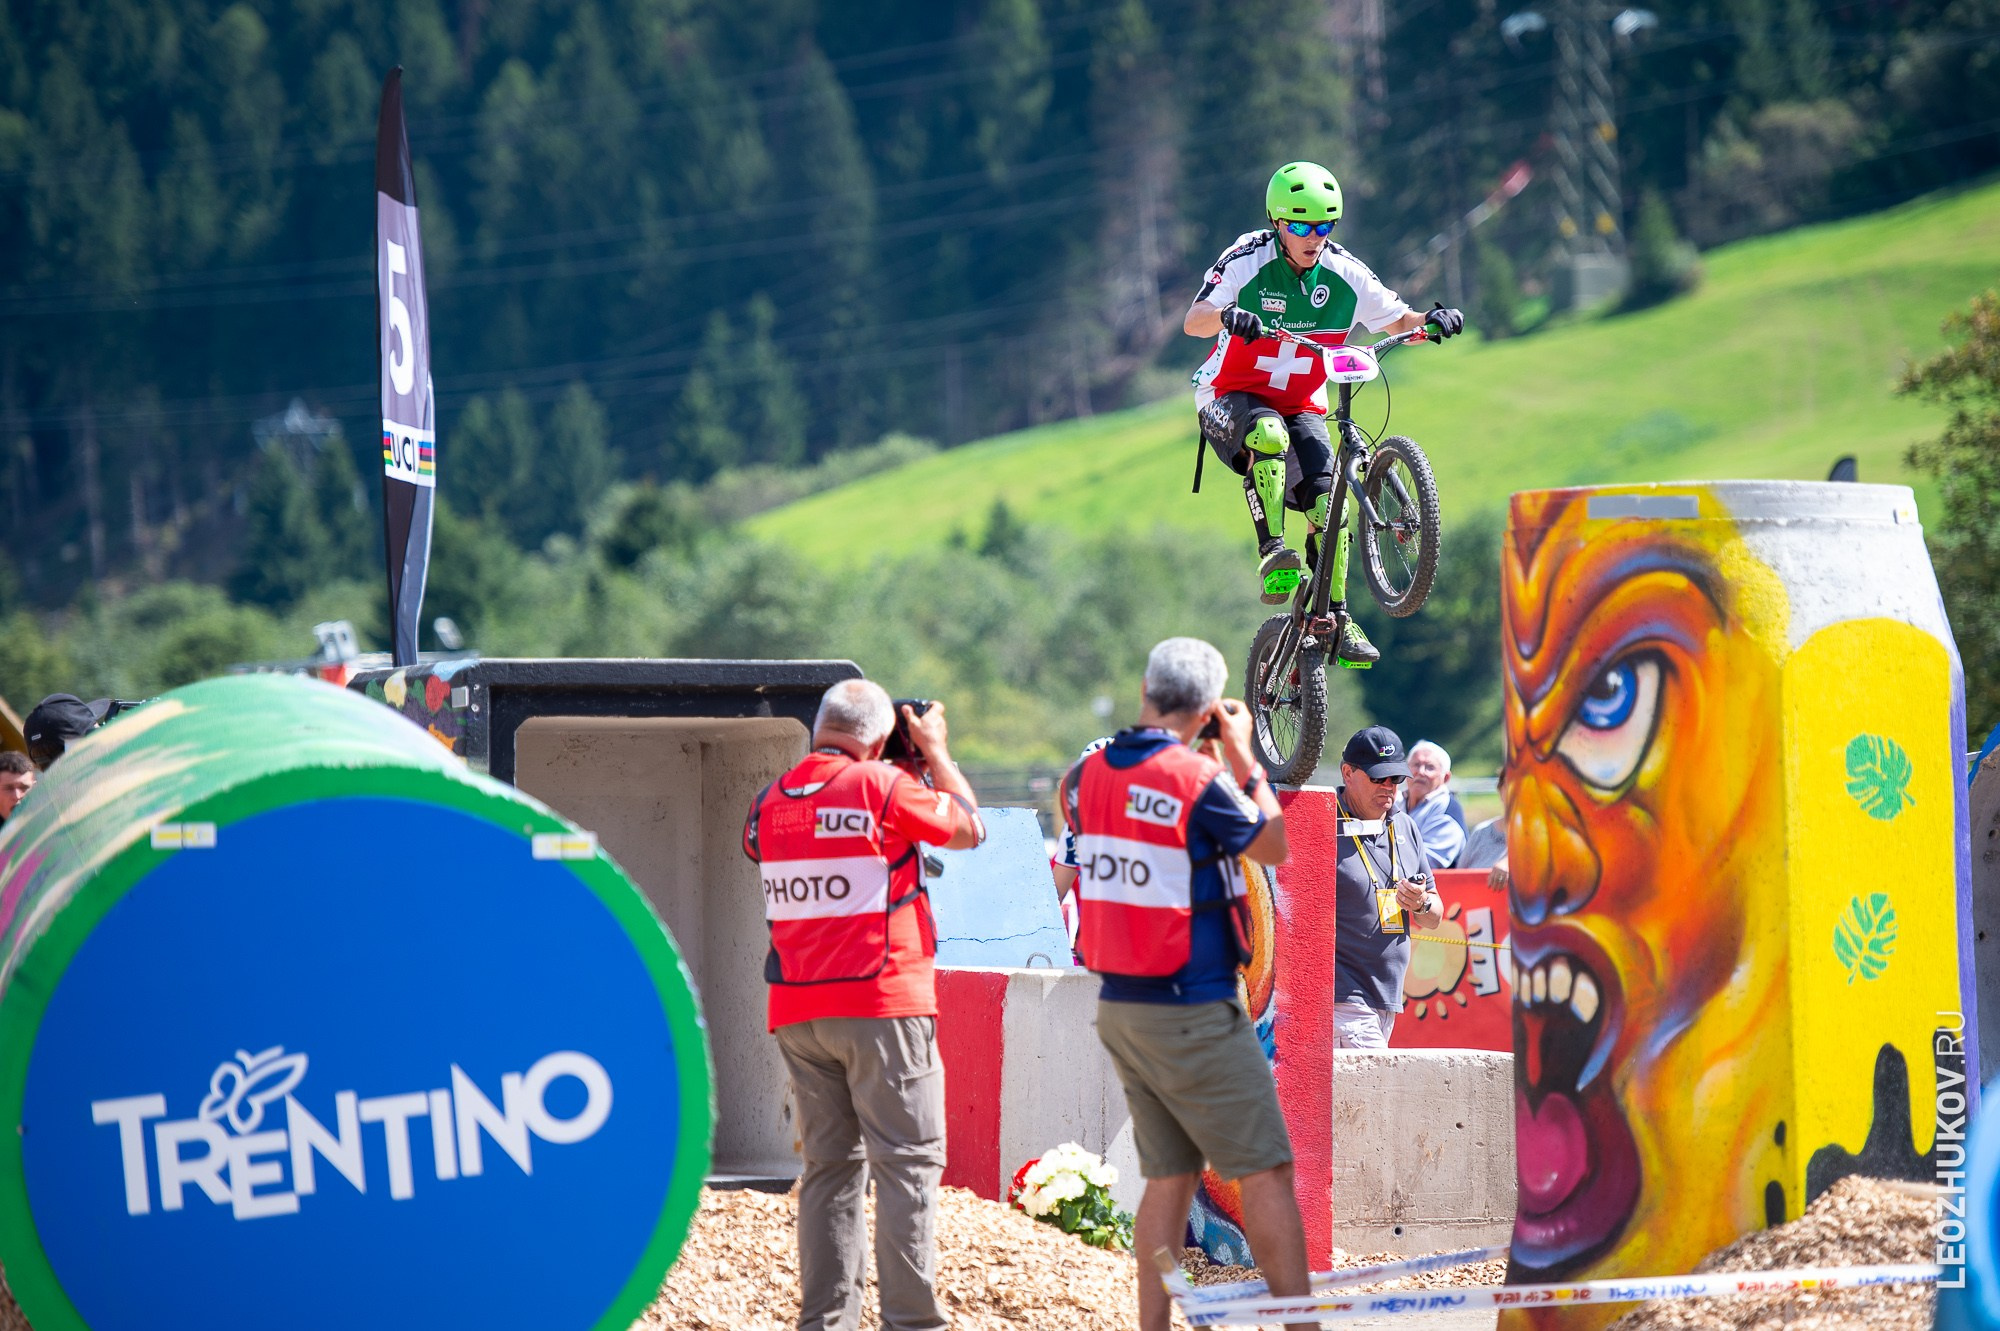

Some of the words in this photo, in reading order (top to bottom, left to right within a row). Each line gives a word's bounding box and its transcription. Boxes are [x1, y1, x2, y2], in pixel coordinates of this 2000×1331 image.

[386, 238, 414, 395] 5
[1282, 320, 1317, 329] vaudoise
[1346, 357, 1358, 371] 4
[391, 432, 416, 473] UCI
[1134, 793, 1176, 819] UCI
[824, 813, 870, 833] UCI
[1083, 854, 1150, 887] HOTO
[764, 875, 850, 904] PHOTO
[91, 1049, 614, 1221] TRENTINO
